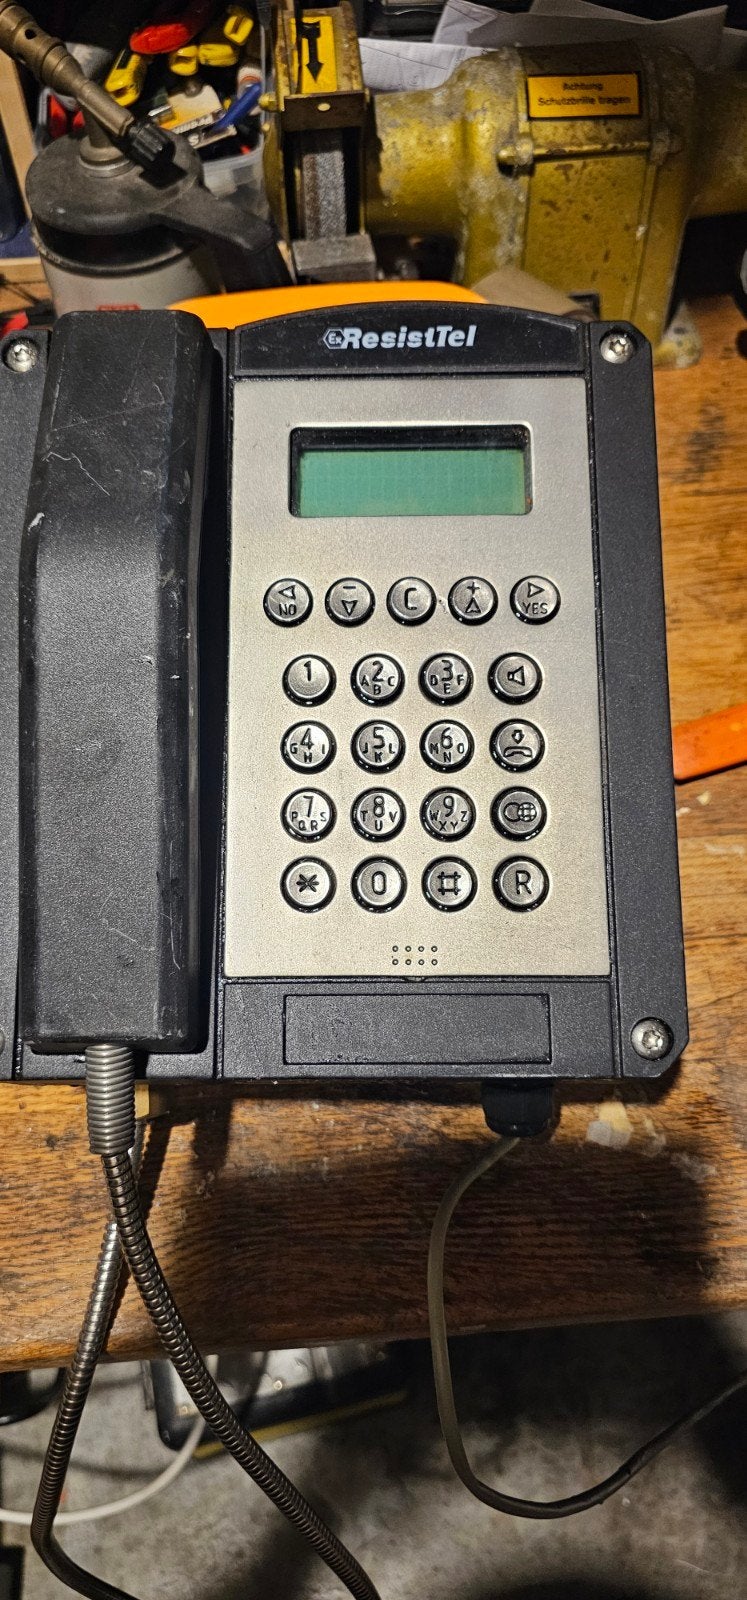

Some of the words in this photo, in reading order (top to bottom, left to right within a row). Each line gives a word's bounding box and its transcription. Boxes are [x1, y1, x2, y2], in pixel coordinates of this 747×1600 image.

[538, 97, 596, 106] Schutzbrille
[598, 97, 632, 106] tragen
[341, 325, 477, 349] ResistTel
[278, 603, 297, 616] NO
[403, 587, 418, 611] C
[522, 602, 549, 615] YES
[303, 660, 313, 682] 1
[371, 660, 384, 683] 2
[441, 659, 454, 682] 3
[300, 728, 315, 750] 4
[372, 726, 386, 750] 5
[441, 726, 454, 750] 6
[303, 795, 315, 818] 7
[373, 795, 386, 818] 8
[442, 795, 455, 818] 9
[515, 869, 532, 895] R
